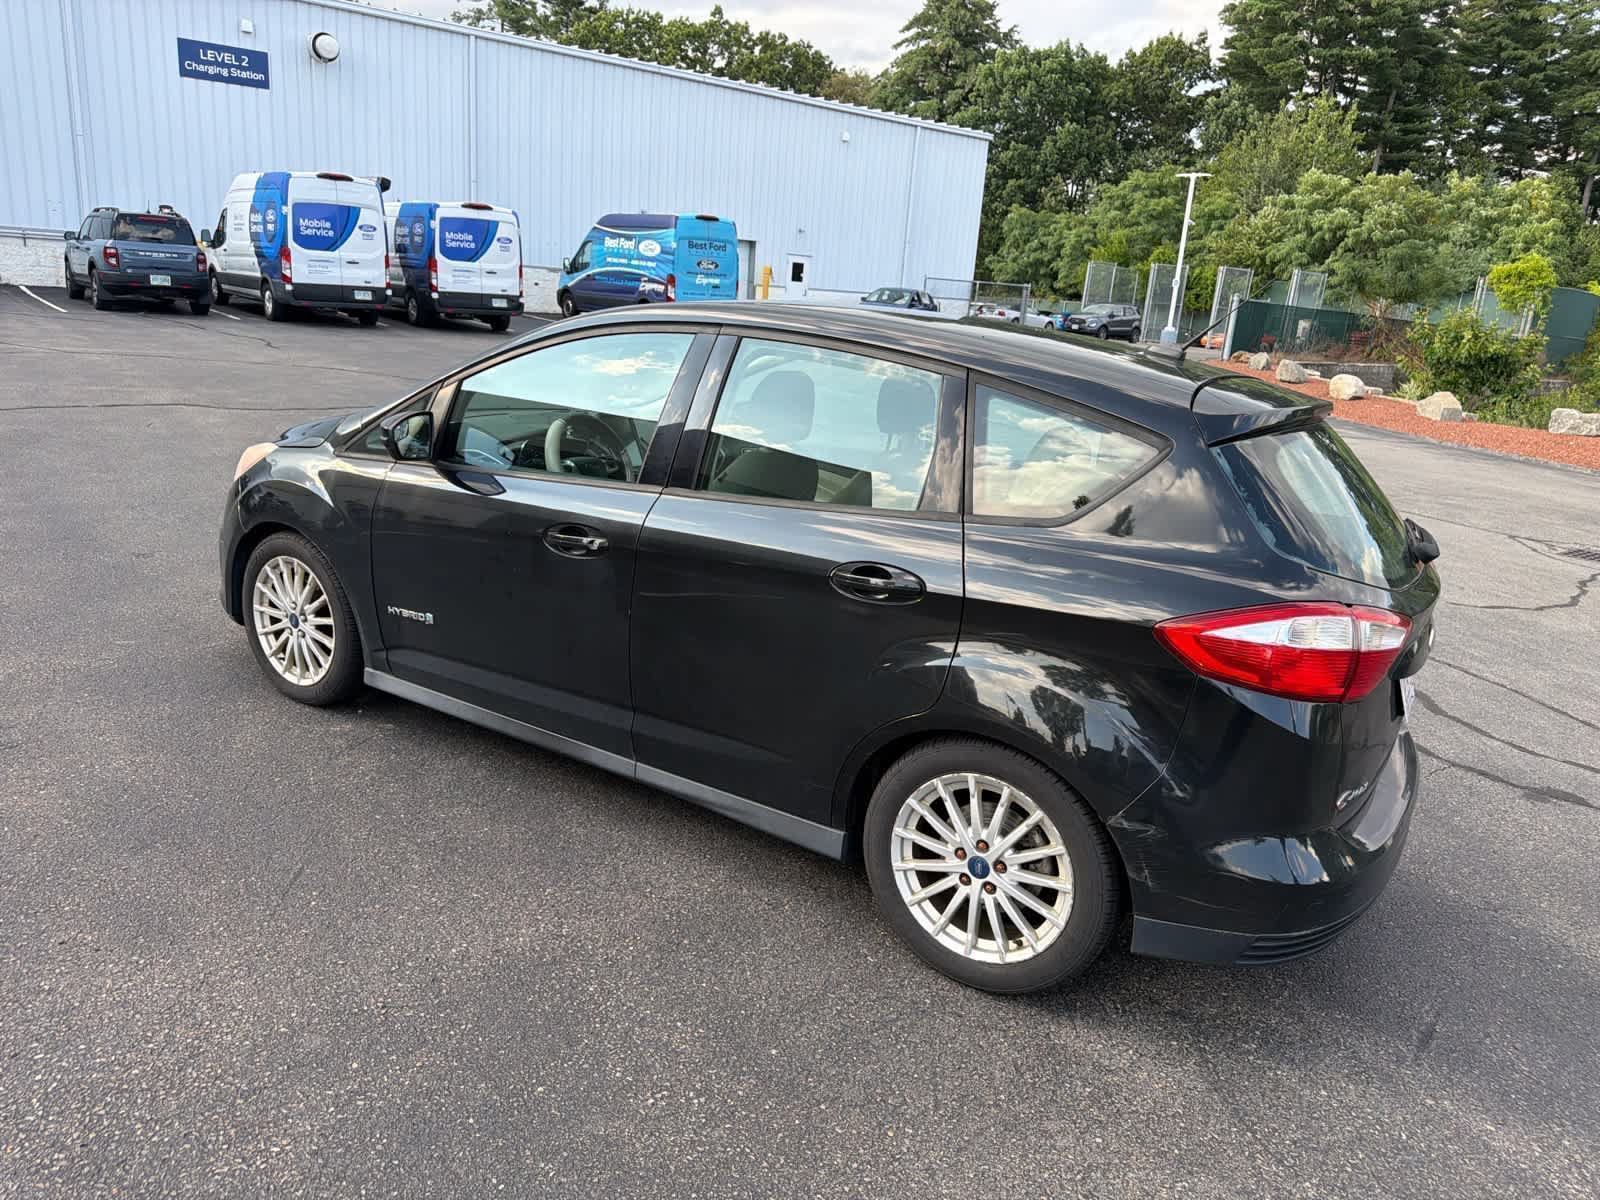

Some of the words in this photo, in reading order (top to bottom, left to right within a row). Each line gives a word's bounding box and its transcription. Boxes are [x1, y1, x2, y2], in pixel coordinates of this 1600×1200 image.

[200, 49, 239, 65] LEVEL
[241, 56, 249, 67] 2
[184, 60, 229, 77] Charging
[230, 68, 265, 80] Station
[300, 218, 331, 228] Mobile
[300, 226, 334, 237] Service
[445, 232, 473, 241] Mobile
[445, 240, 476, 249] Service
[604, 237, 618, 249] Best
[620, 238, 635, 250] Ford
[688, 240, 707, 250] Best
[709, 242, 727, 252] Ford
[387, 605, 425, 621] HYBRID
